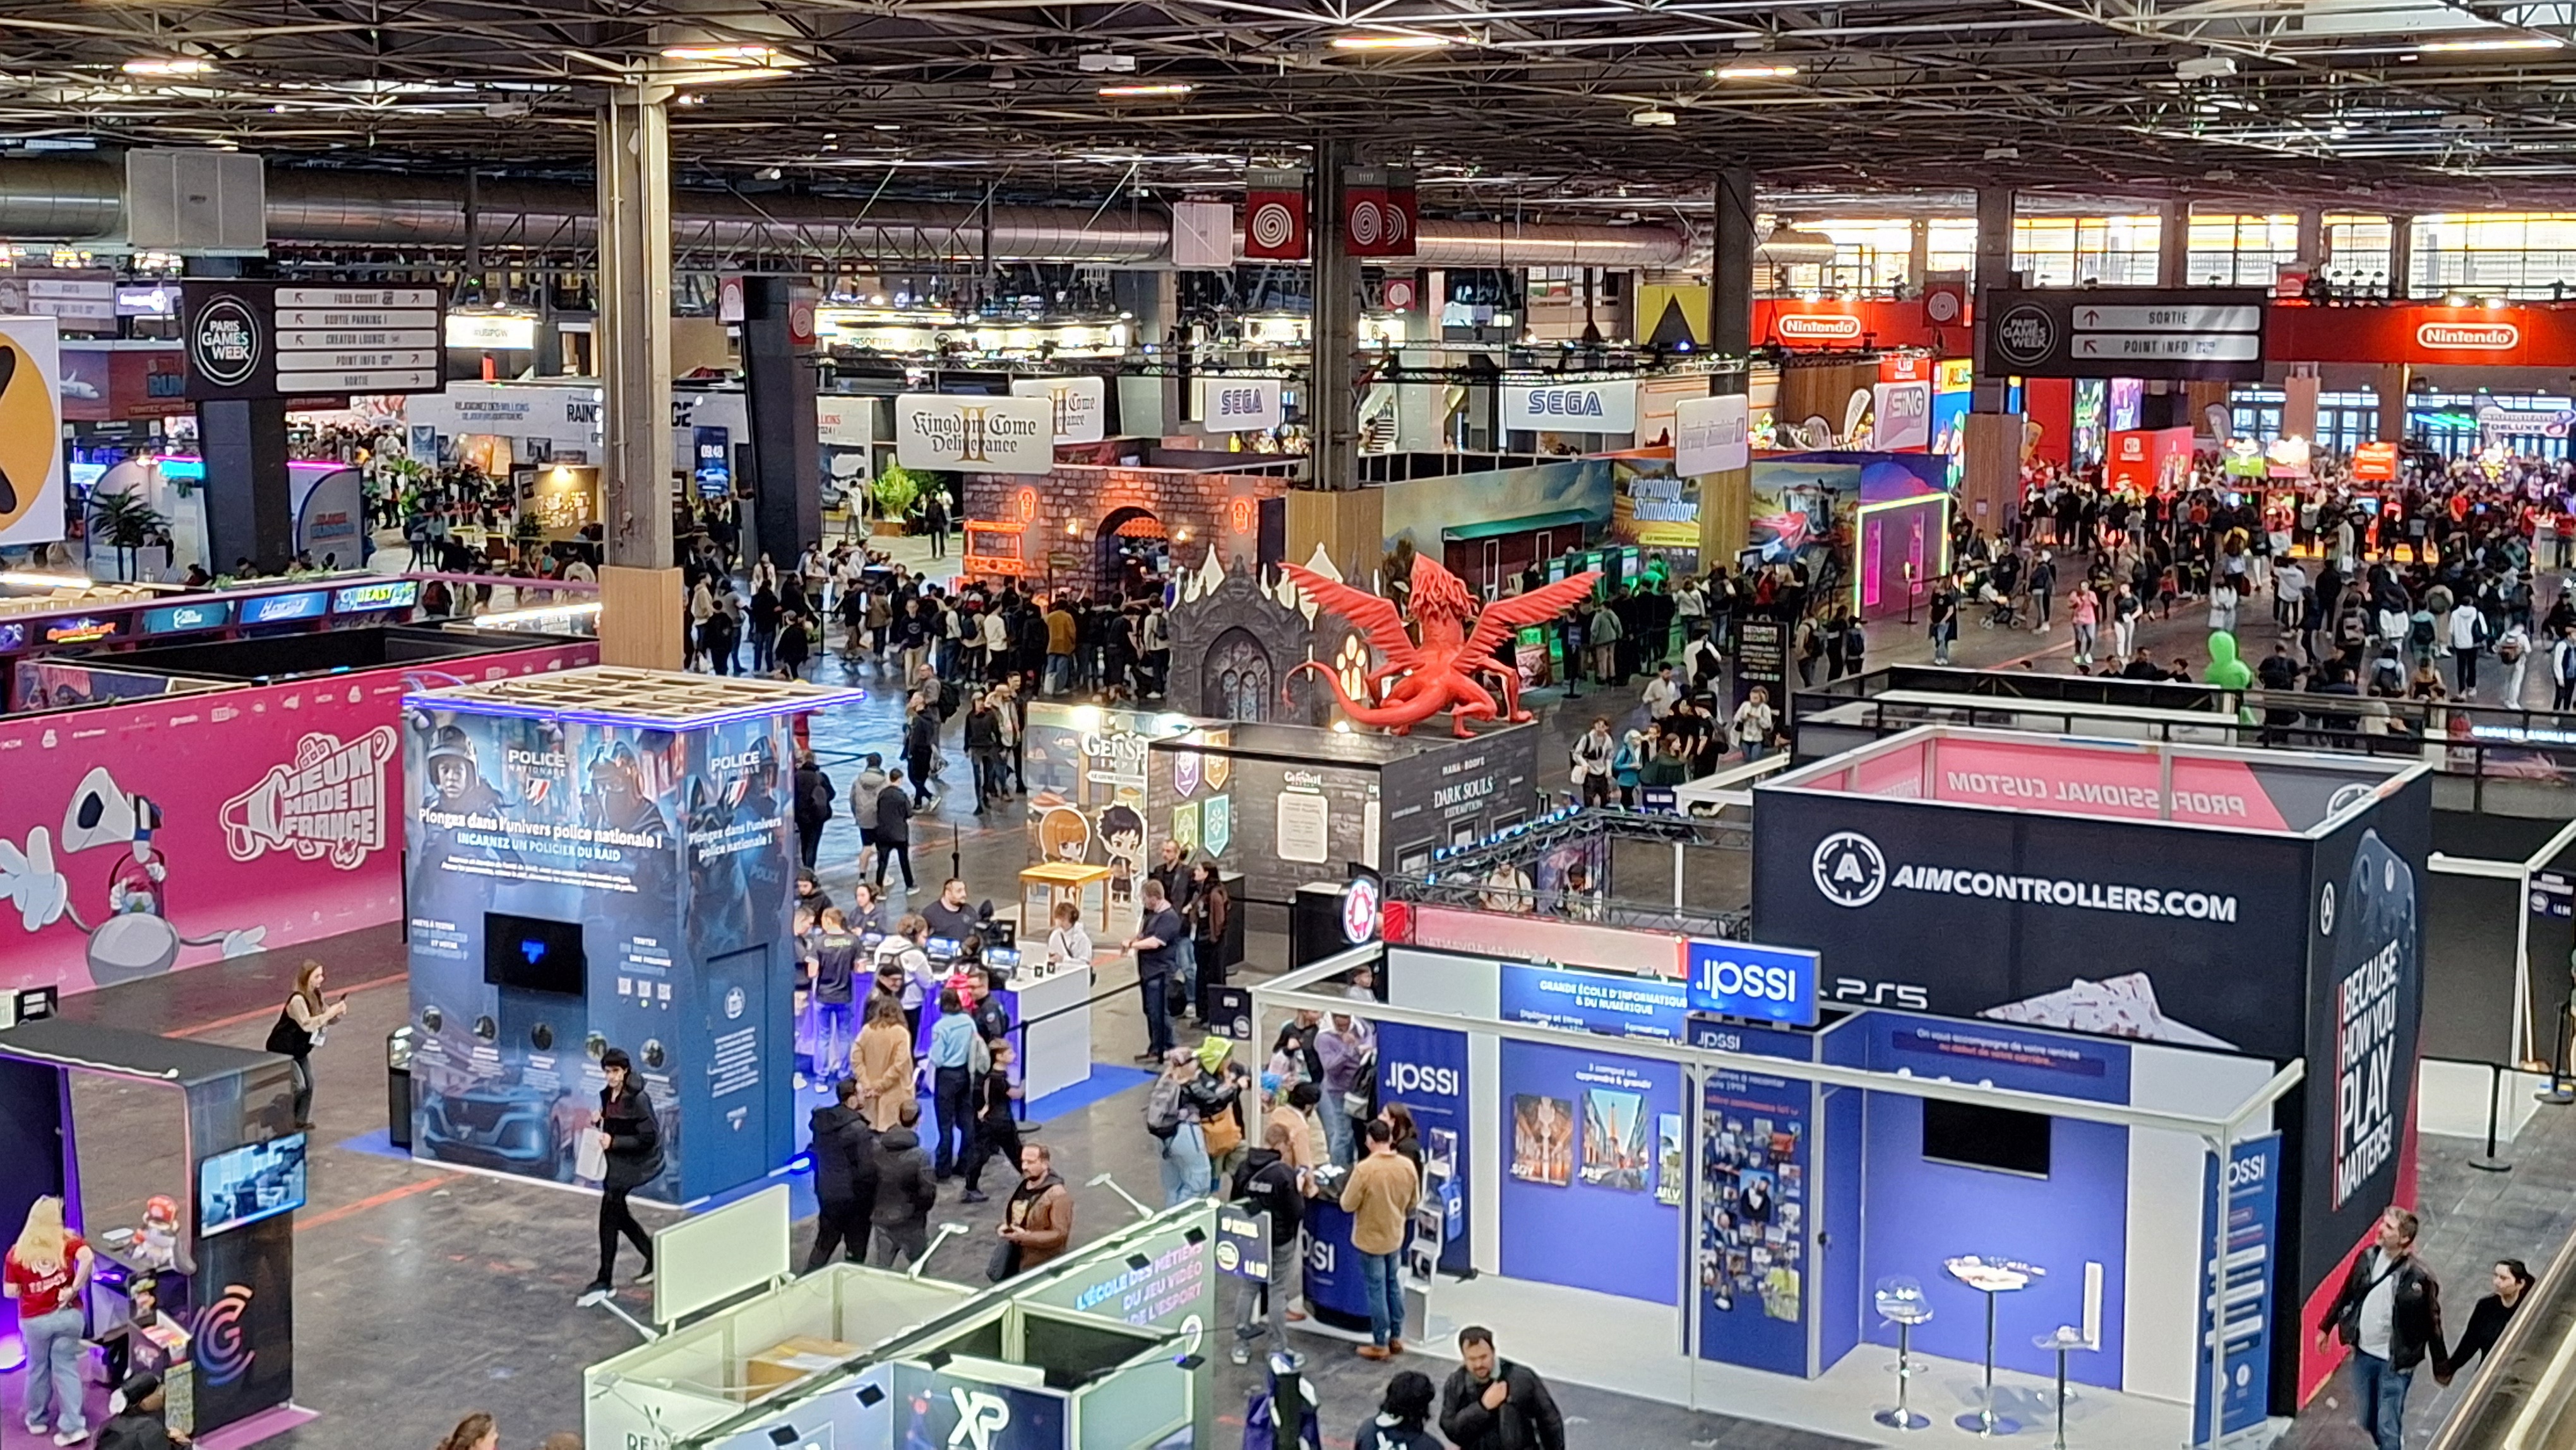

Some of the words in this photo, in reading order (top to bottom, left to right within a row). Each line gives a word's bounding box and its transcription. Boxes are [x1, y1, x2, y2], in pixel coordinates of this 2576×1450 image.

[210, 320, 241, 332] PARIS
[325, 314, 349, 325] SORTIE
[352, 314, 381, 325] PARKING
[1786, 318, 1854, 335] Nintendo
[2149, 311, 2188, 324] SORTIE
[201, 332, 249, 347] GAMES
[325, 334, 357, 345] CREATOR
[359, 333, 386, 345] LOUNGE
[2002, 327, 2047, 338] GAMES
[2010, 337, 2048, 349] WEEK
[2426, 328, 2508, 344] Nintendo
[212, 345, 250, 360] WEEK
[2124, 340, 2157, 354] POINT
[2162, 340, 2188, 353] INFO
[336, 354, 358, 365] POINT
[360, 354, 376, 365] INFO
[344, 375, 368, 386] SORTIE
[1068, 393, 1095, 412] Come
[1220, 387, 1265, 416] SEGA
[1527, 389, 1604, 417] SEGA
[566, 404, 600, 423] RAIN
[912, 411, 986, 436] Kingdom
[989, 414, 1036, 436] Come
[2491, 423, 2541, 431] DELUXE
[1627, 475, 1683, 502] Farming
[1633, 498, 1698, 522] Simulator
[508, 749, 566, 768] POLICE
[711, 750, 761, 772] POLICE
[508, 764, 566, 778] NATIONALE
[283, 781, 348, 815] MADE
[350, 774, 374, 808] IN
[1433, 784, 1462, 809] DARK
[1462, 775, 1494, 800] SOULS
[283, 807, 375, 845] FRANCE
[418, 808, 465, 830] Plongez
[467, 812, 498, 831] dans
[499, 815, 551, 837] l'univers
[553, 824, 592, 841] police
[593, 828, 655, 849] nationale
[688, 829, 724, 845] Plongez
[725, 824, 745, 836] dans
[456, 832, 510, 851] INCARNEZ
[511, 838, 528, 851] UN
[529, 839, 576, 858] POLICIER
[577, 846, 593, 859] DU
[593, 847, 622, 862] RAID
[698, 844, 726, 863] police
[1892, 865, 2237, 923] AIMCONTROLLERS.COM
[2342, 938, 2399, 1024] BECAUSE
[1539, 980, 1577, 995] GRANDE
[1578, 983, 1607, 997] ÉCOLE
[1609, 988, 1688, 1009] D'INFORMATIQUE
[1836, 977, 1929, 1010] PS5
[1583, 997, 1597, 1009] DU
[1599, 999, 1654, 1016] NUMÉRIQUE
[1916, 1028, 1931, 1040] On
[1931, 1031, 1951, 1042] vous
[2342, 1008, 2371, 1073] HOW
[2371, 986, 2397, 1044] YOU
[2339, 1033, 2395, 1158] PLAY
[2337, 1112, 2393, 1208] MATTERS!
[1076, 1273, 1128, 1311] L'ÉCOLE
[1123, 1289, 1142, 1311] DU
[1142, 1278, 1166, 1302] JEU
[1167, 1261, 1203, 1288] VIDÉO
[1148, 1281, 1203, 1321] L'ESPORT
[948, 1386, 1010, 1449] XP
